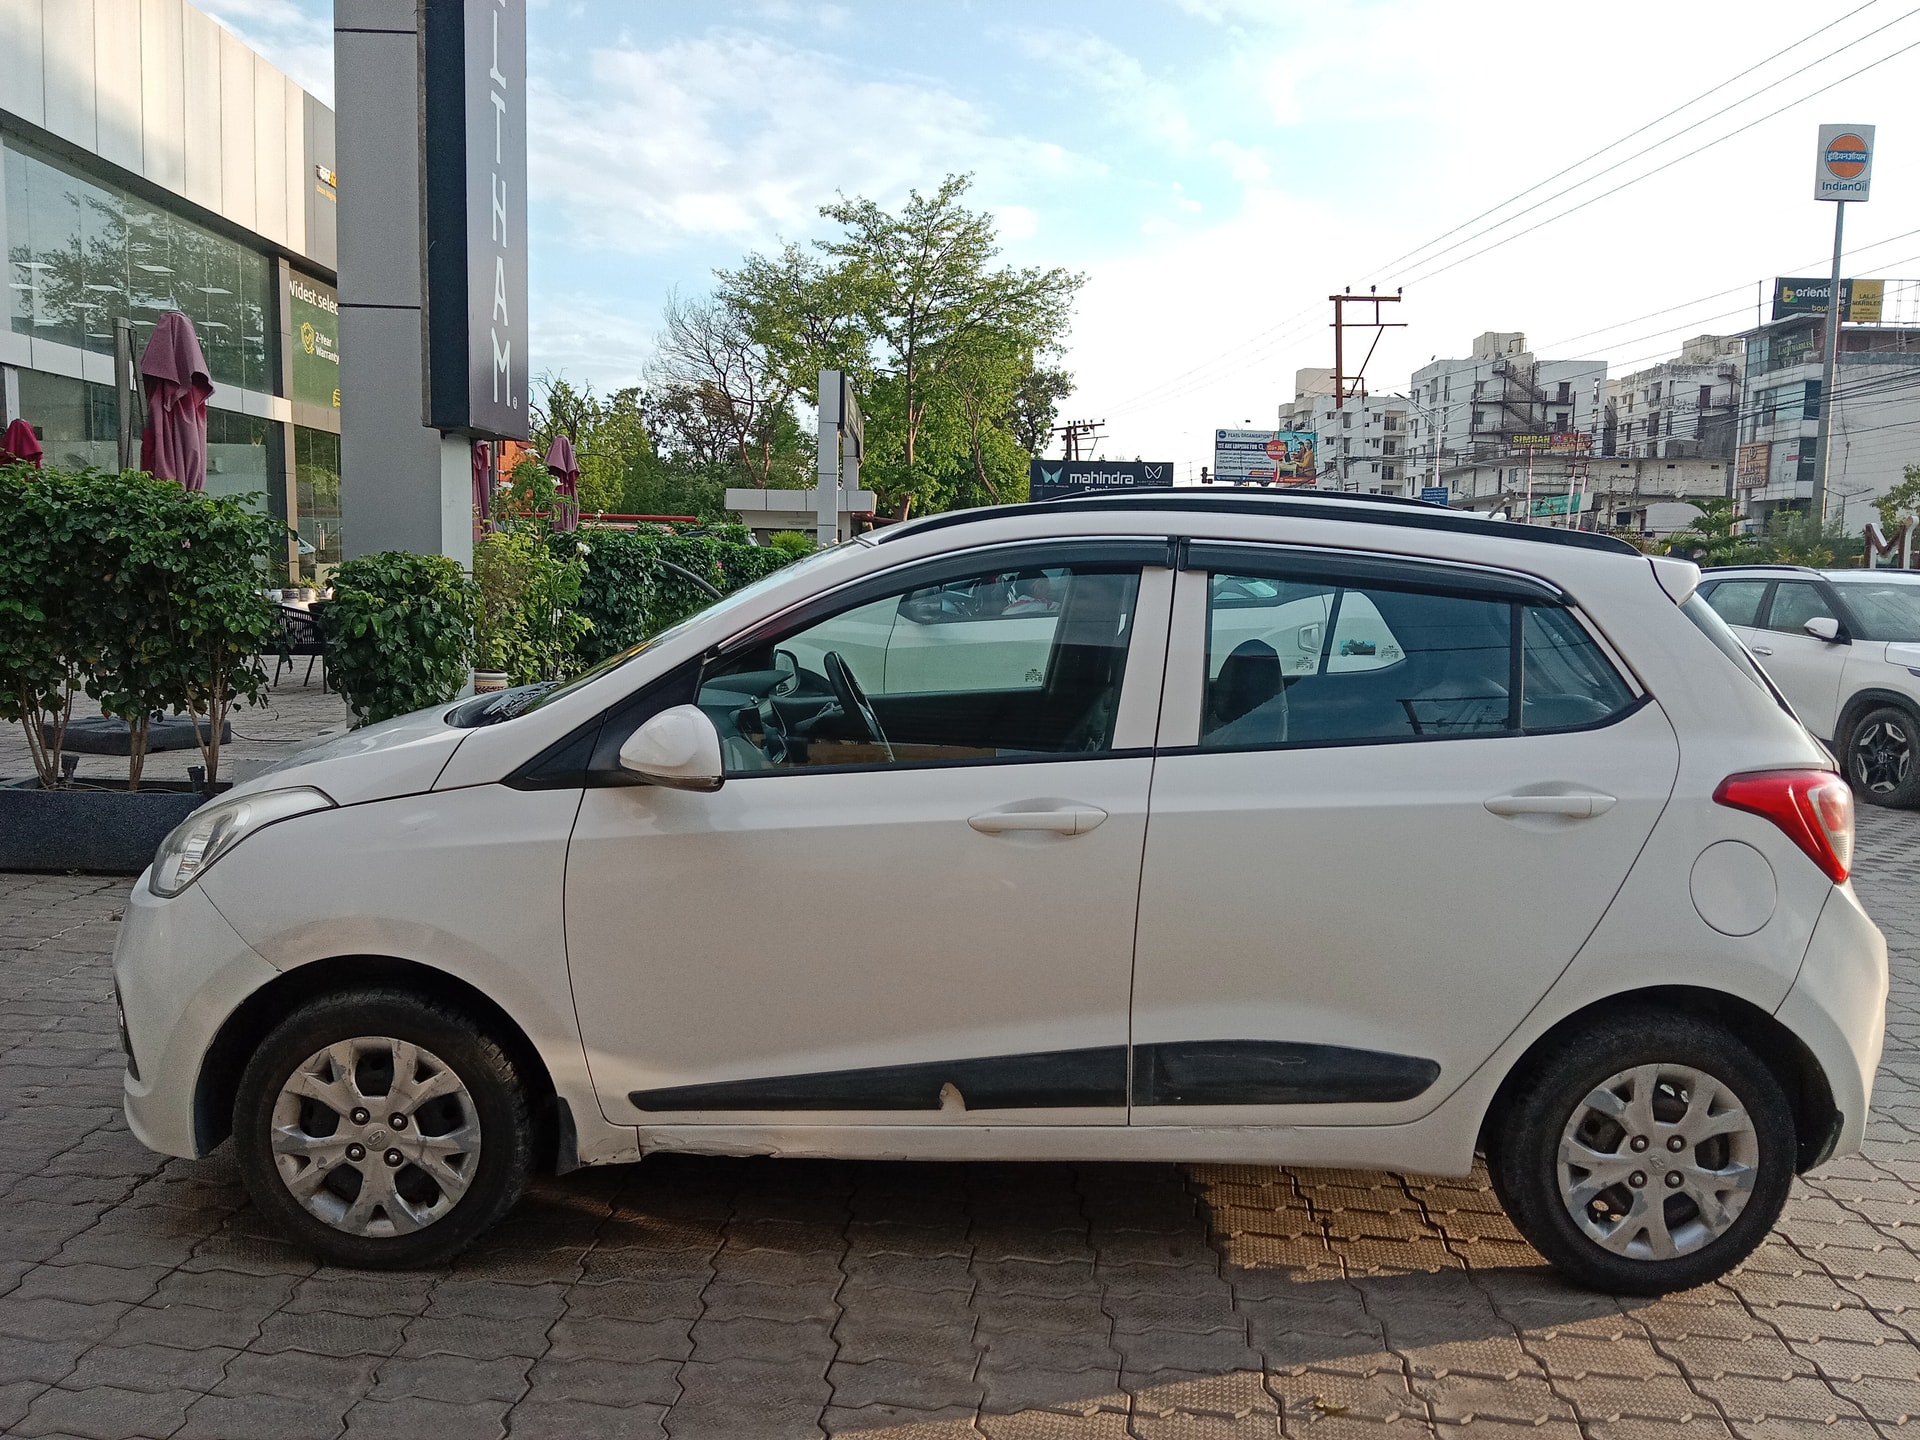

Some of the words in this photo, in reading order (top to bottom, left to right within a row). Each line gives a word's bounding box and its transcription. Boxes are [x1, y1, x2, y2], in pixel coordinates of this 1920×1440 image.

[1822, 181, 1867, 192] IndianOil
[315, 331, 332, 347] 2-Year
[315, 345, 339, 365] Warranty
[1069, 471, 1134, 485] mahindra
